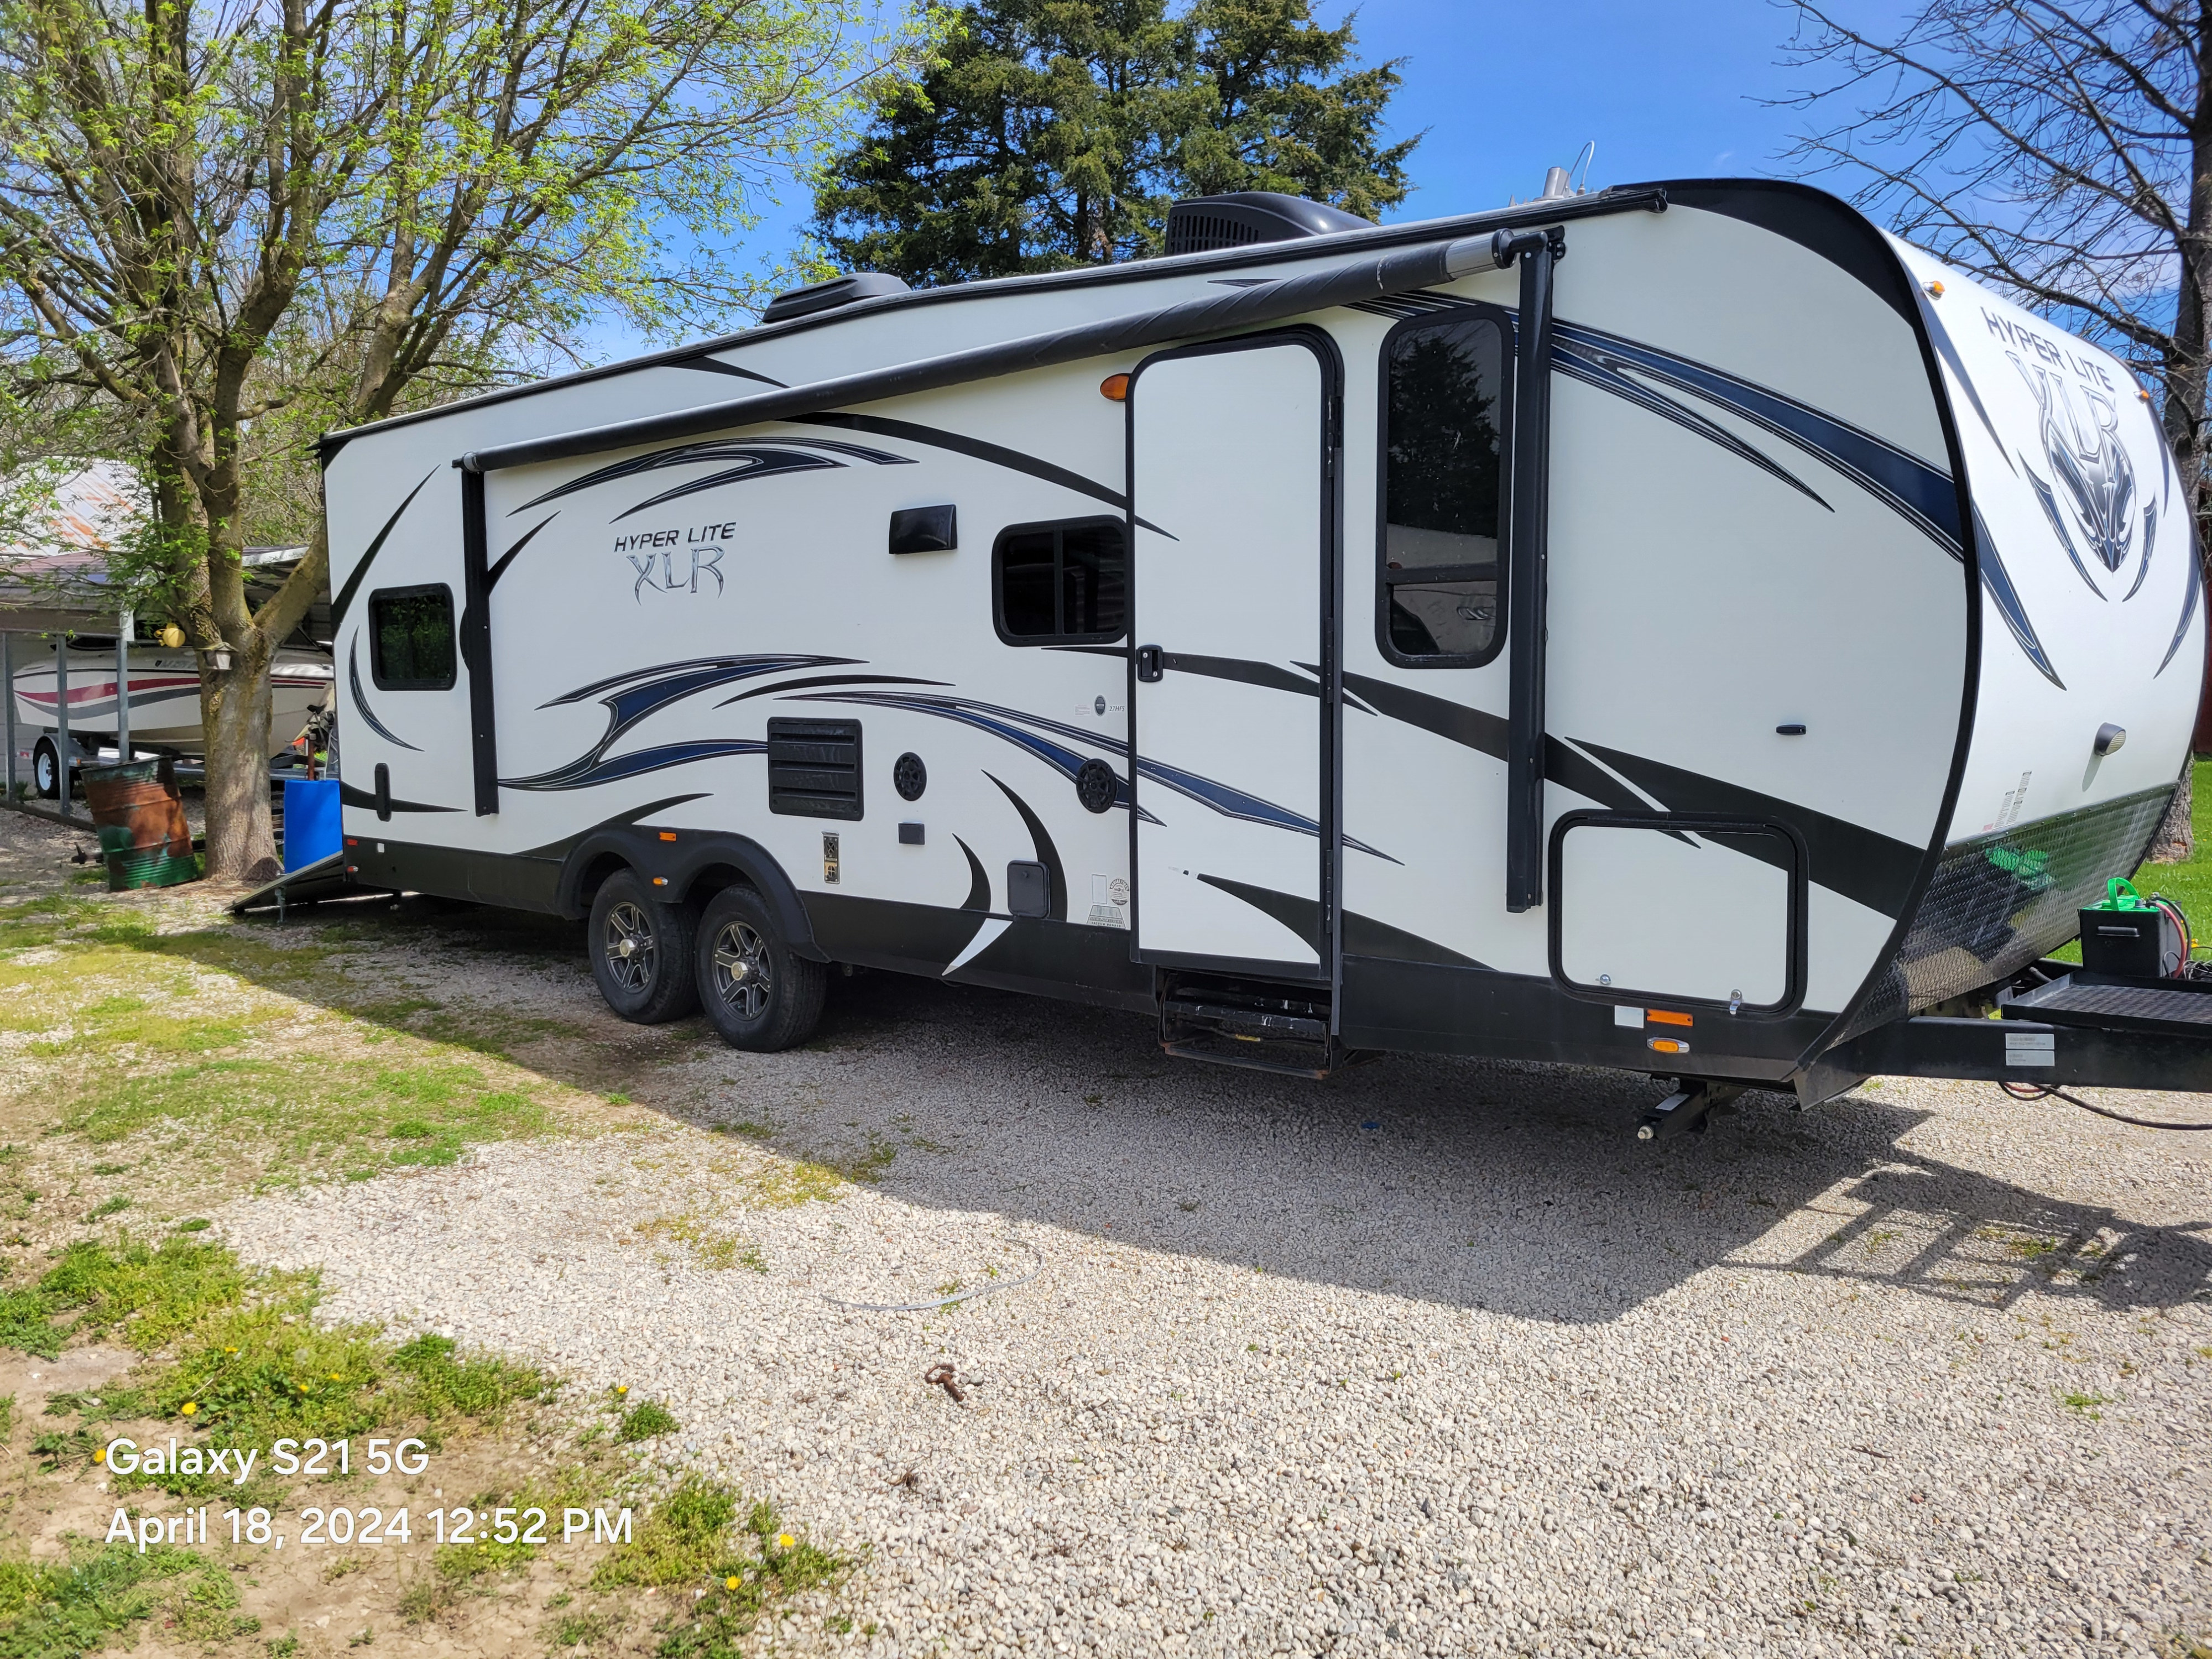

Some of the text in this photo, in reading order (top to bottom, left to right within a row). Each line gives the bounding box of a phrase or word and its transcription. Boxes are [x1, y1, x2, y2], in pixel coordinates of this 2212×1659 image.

[1980, 306, 2115, 393] HYPER LITE
[2005, 349, 2137, 507] XLR
[614, 522, 737, 552] HYPER LITE
[626, 545, 725, 606] XLR
